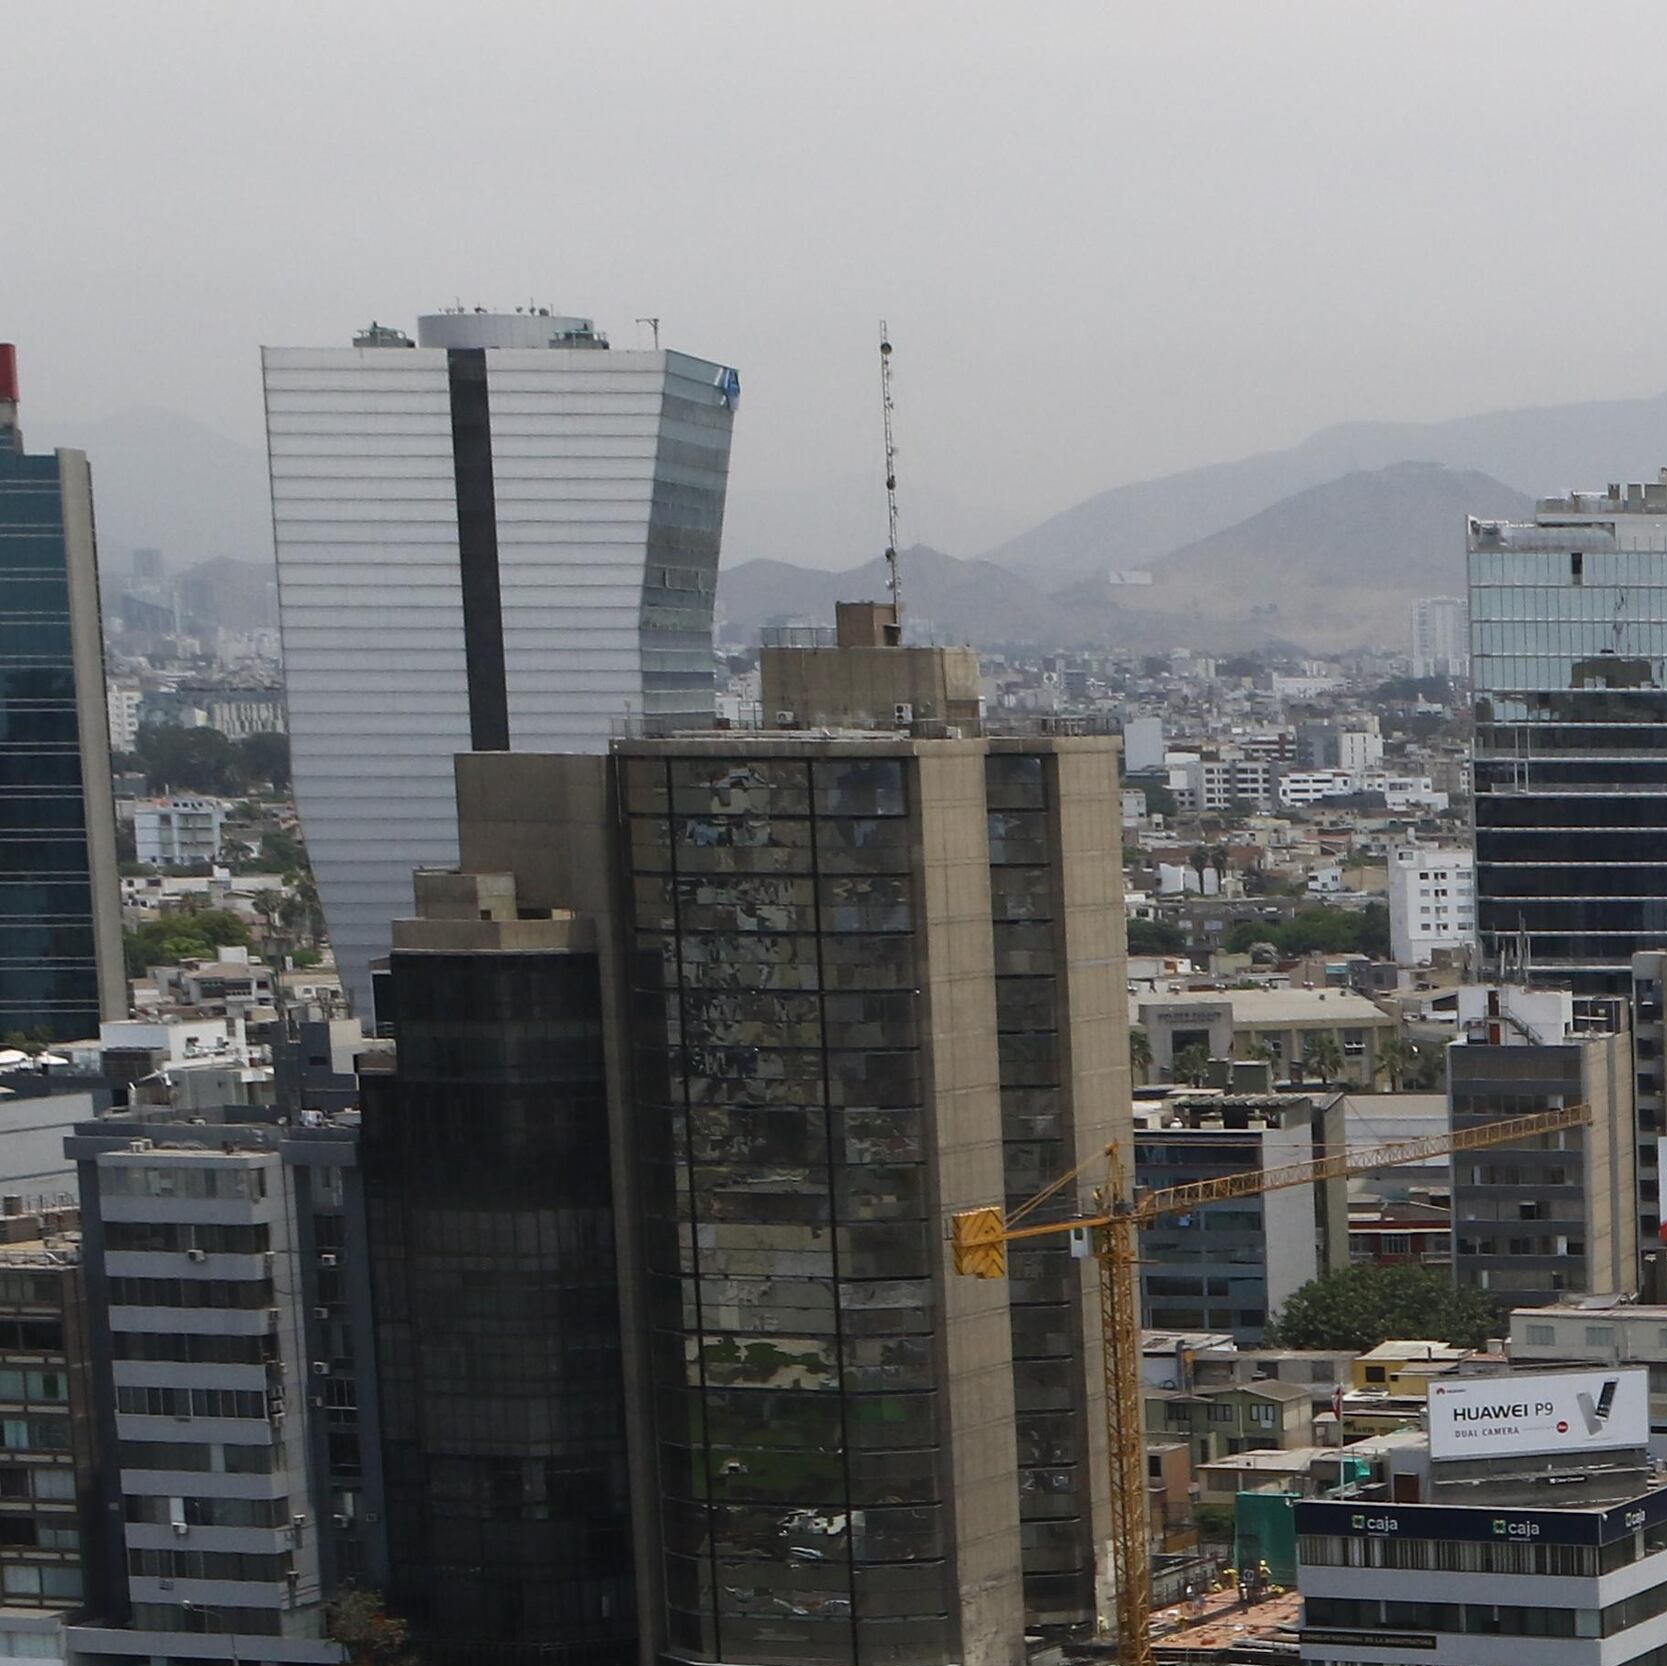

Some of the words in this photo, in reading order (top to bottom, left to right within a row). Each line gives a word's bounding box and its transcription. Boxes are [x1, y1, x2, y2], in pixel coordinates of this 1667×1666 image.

[1453, 1403, 1529, 1422] HUAWEI
[1535, 1402, 1554, 1416] P9
[1455, 1427, 1479, 1439] DUAL
[1482, 1425, 1520, 1438] CAMERA
[1367, 1516, 1398, 1532] caja
[1507, 1521, 1540, 1537] caja
